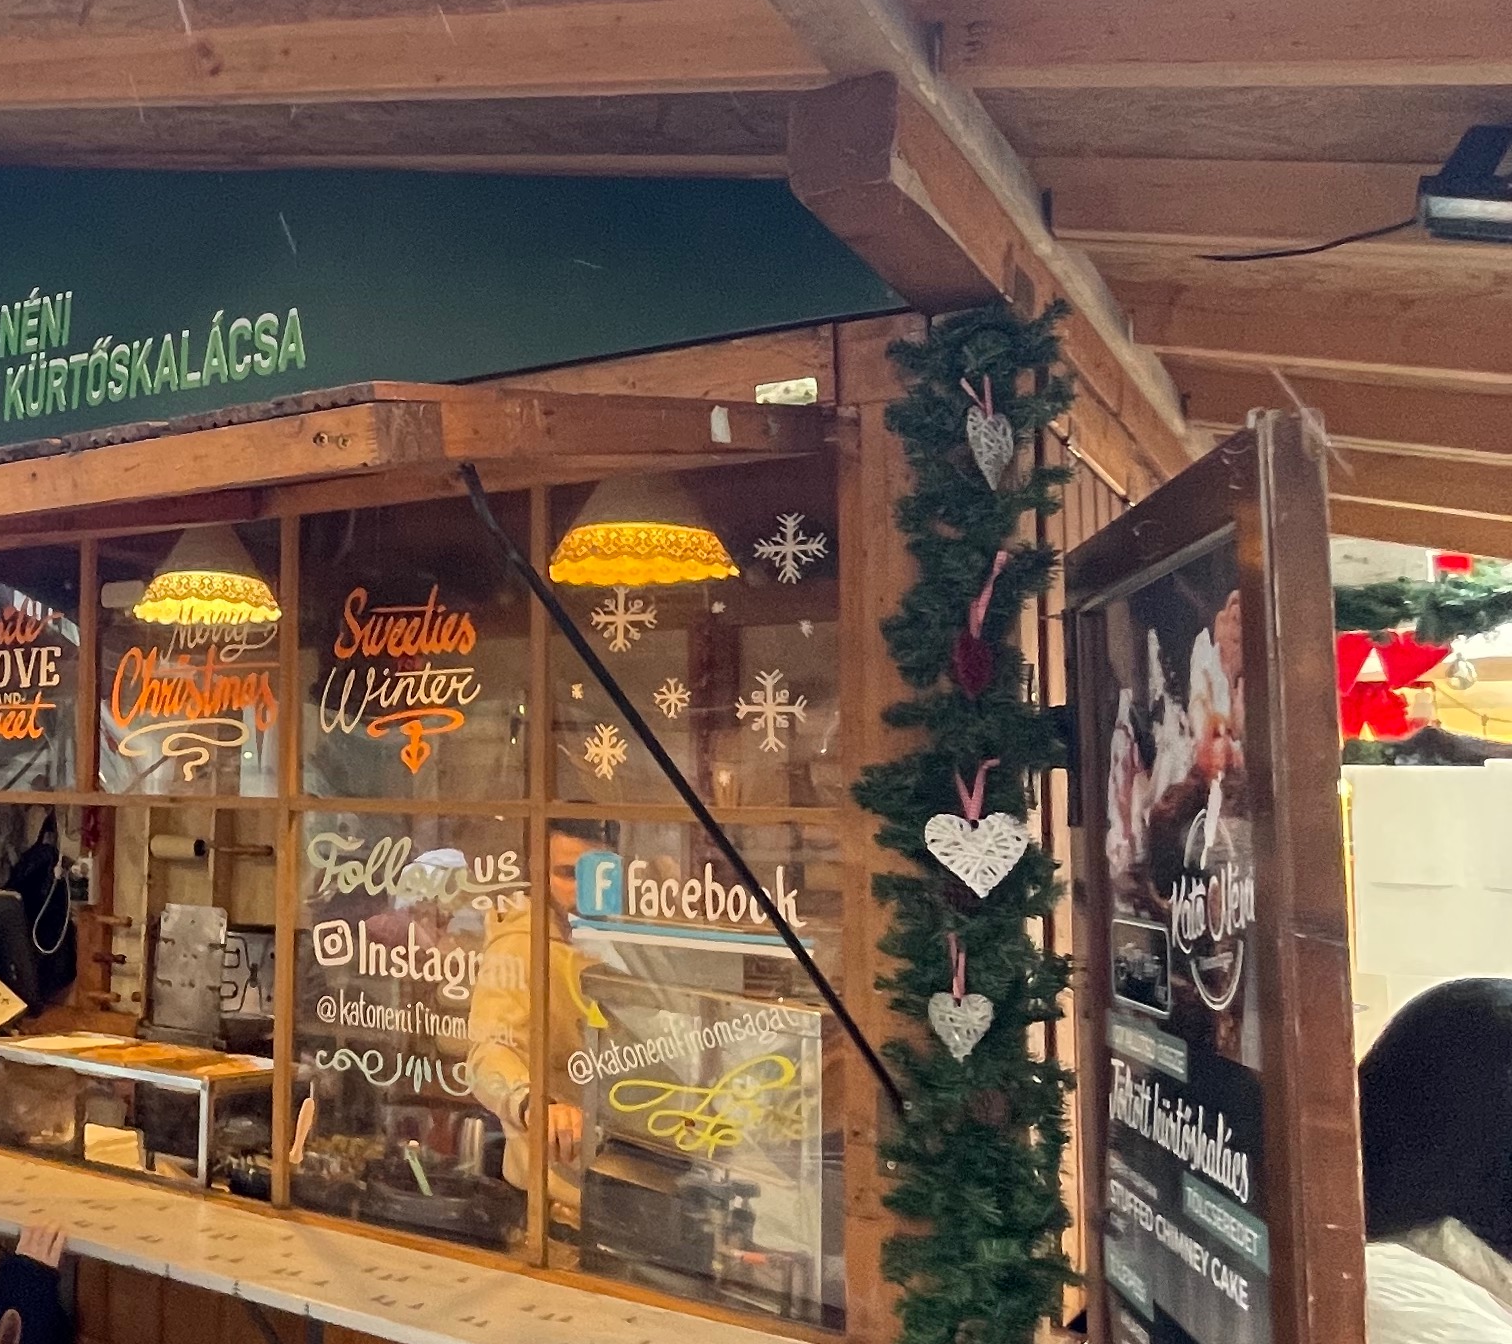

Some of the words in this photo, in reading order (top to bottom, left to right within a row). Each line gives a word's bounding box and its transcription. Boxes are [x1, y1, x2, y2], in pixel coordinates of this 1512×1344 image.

[3, 307, 306, 422] KÜRTŐSKALÁCSA
[334, 583, 477, 660] Sweeties
[111, 644, 281, 732] Christmas
[319, 661, 481, 734] Winter
[304, 832, 513, 903] Follow
[357, 919, 527, 1001] Instagram
[1211, 1257, 1251, 1312] CAKE
